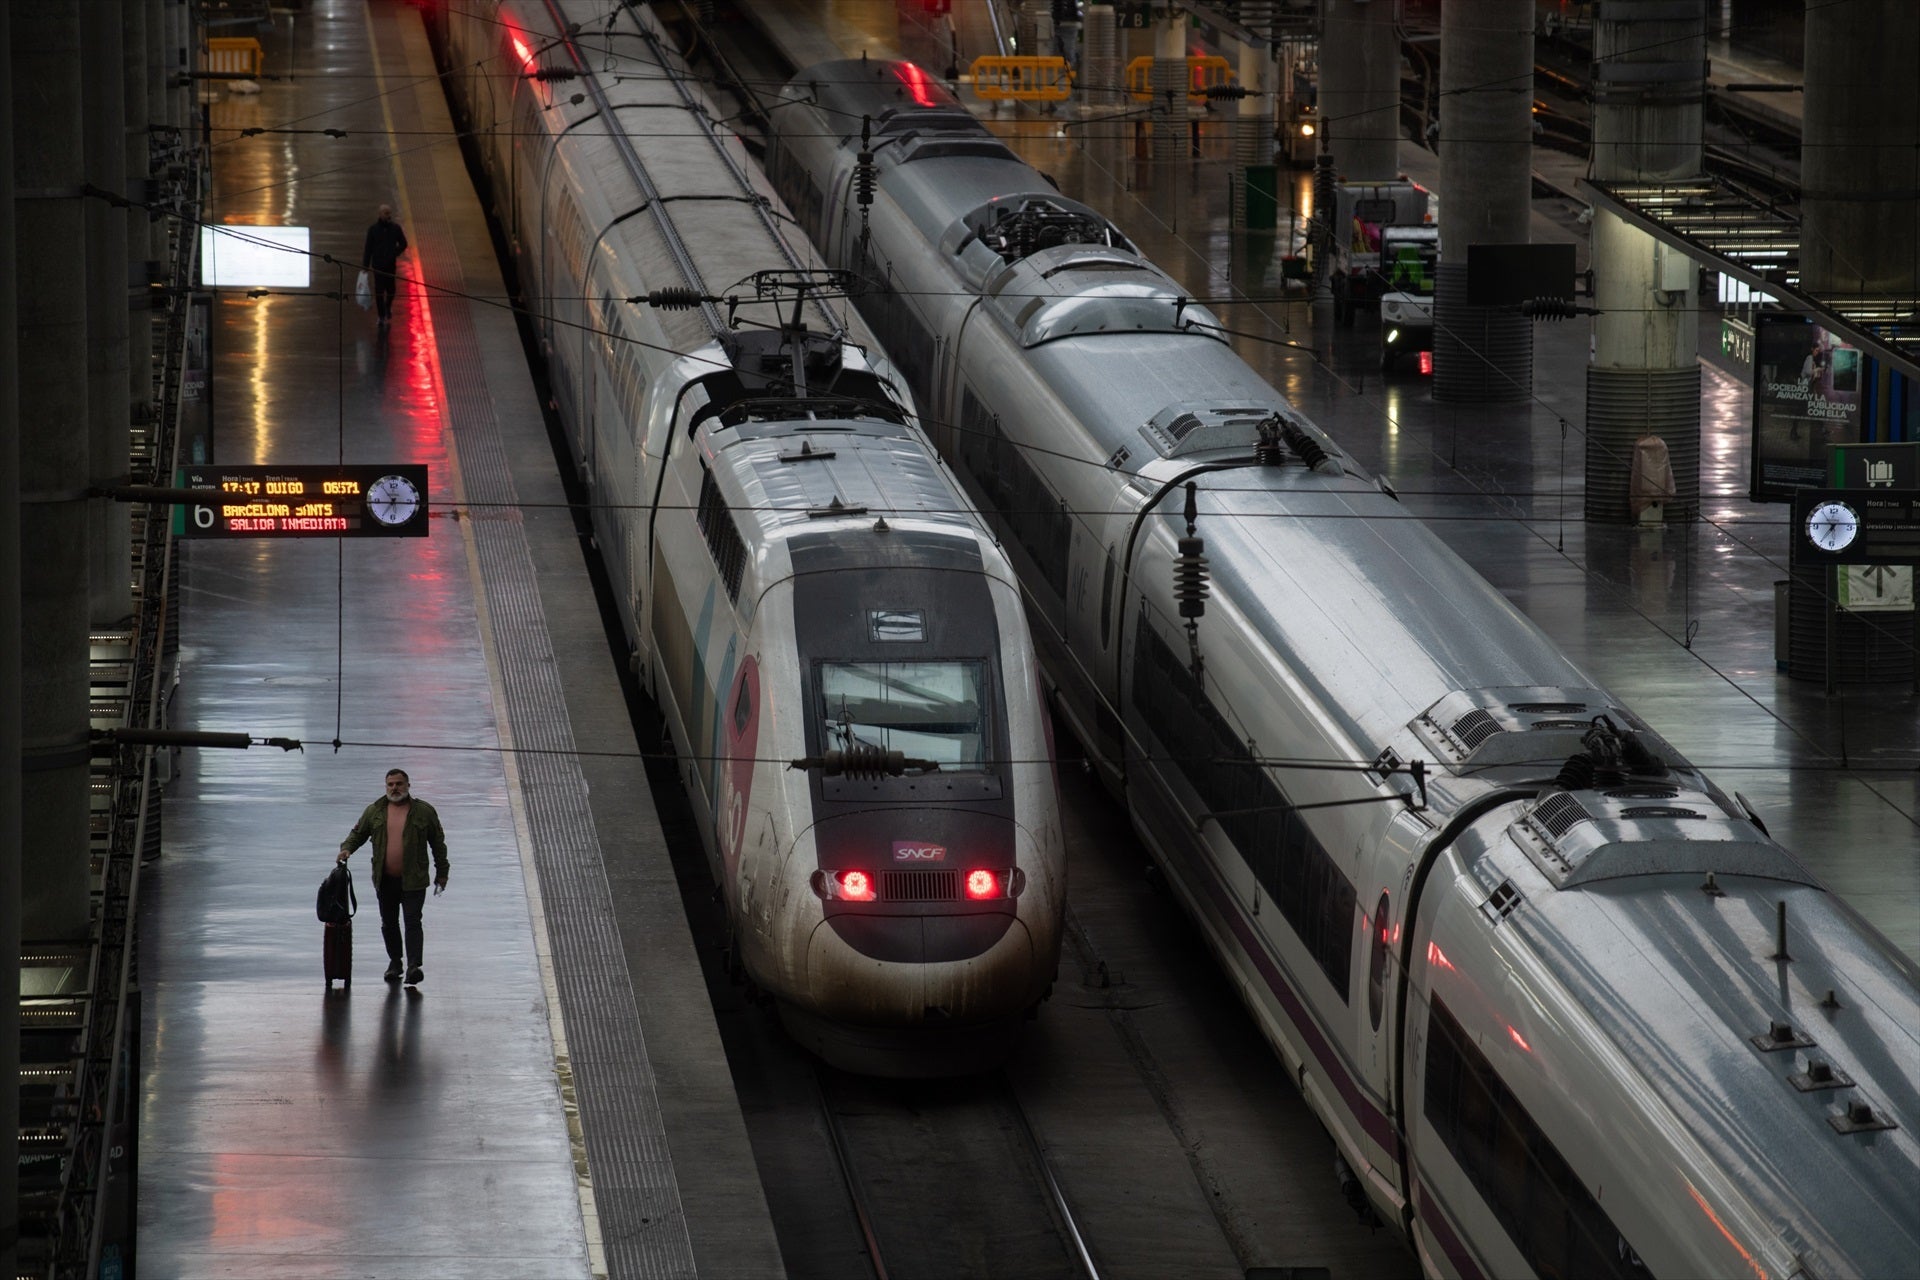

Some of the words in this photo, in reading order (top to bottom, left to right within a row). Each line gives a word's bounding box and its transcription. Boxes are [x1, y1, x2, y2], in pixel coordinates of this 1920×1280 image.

[1797, 377, 1809, 385] LA
[1767, 382, 1809, 393] SOCIEDAD
[1776, 391, 1808, 401] AVANZA
[1814, 393, 1826, 402] LA
[1807, 400, 1857, 412] PUBLICIDAD
[1807, 408, 1826, 417] CON
[1827, 410, 1848, 419] ELLA
[222, 481, 261, 495] 17:17
[265, 481, 304, 495] OUIGO
[1866, 499, 1884, 508] Hora
[194, 503, 215, 528] 6
[222, 503, 290, 517] BARCELONA
[230, 517, 276, 531] SALIDA
[281, 517, 348, 531] INMEDIATA
[895, 847, 944, 860] SNCF
